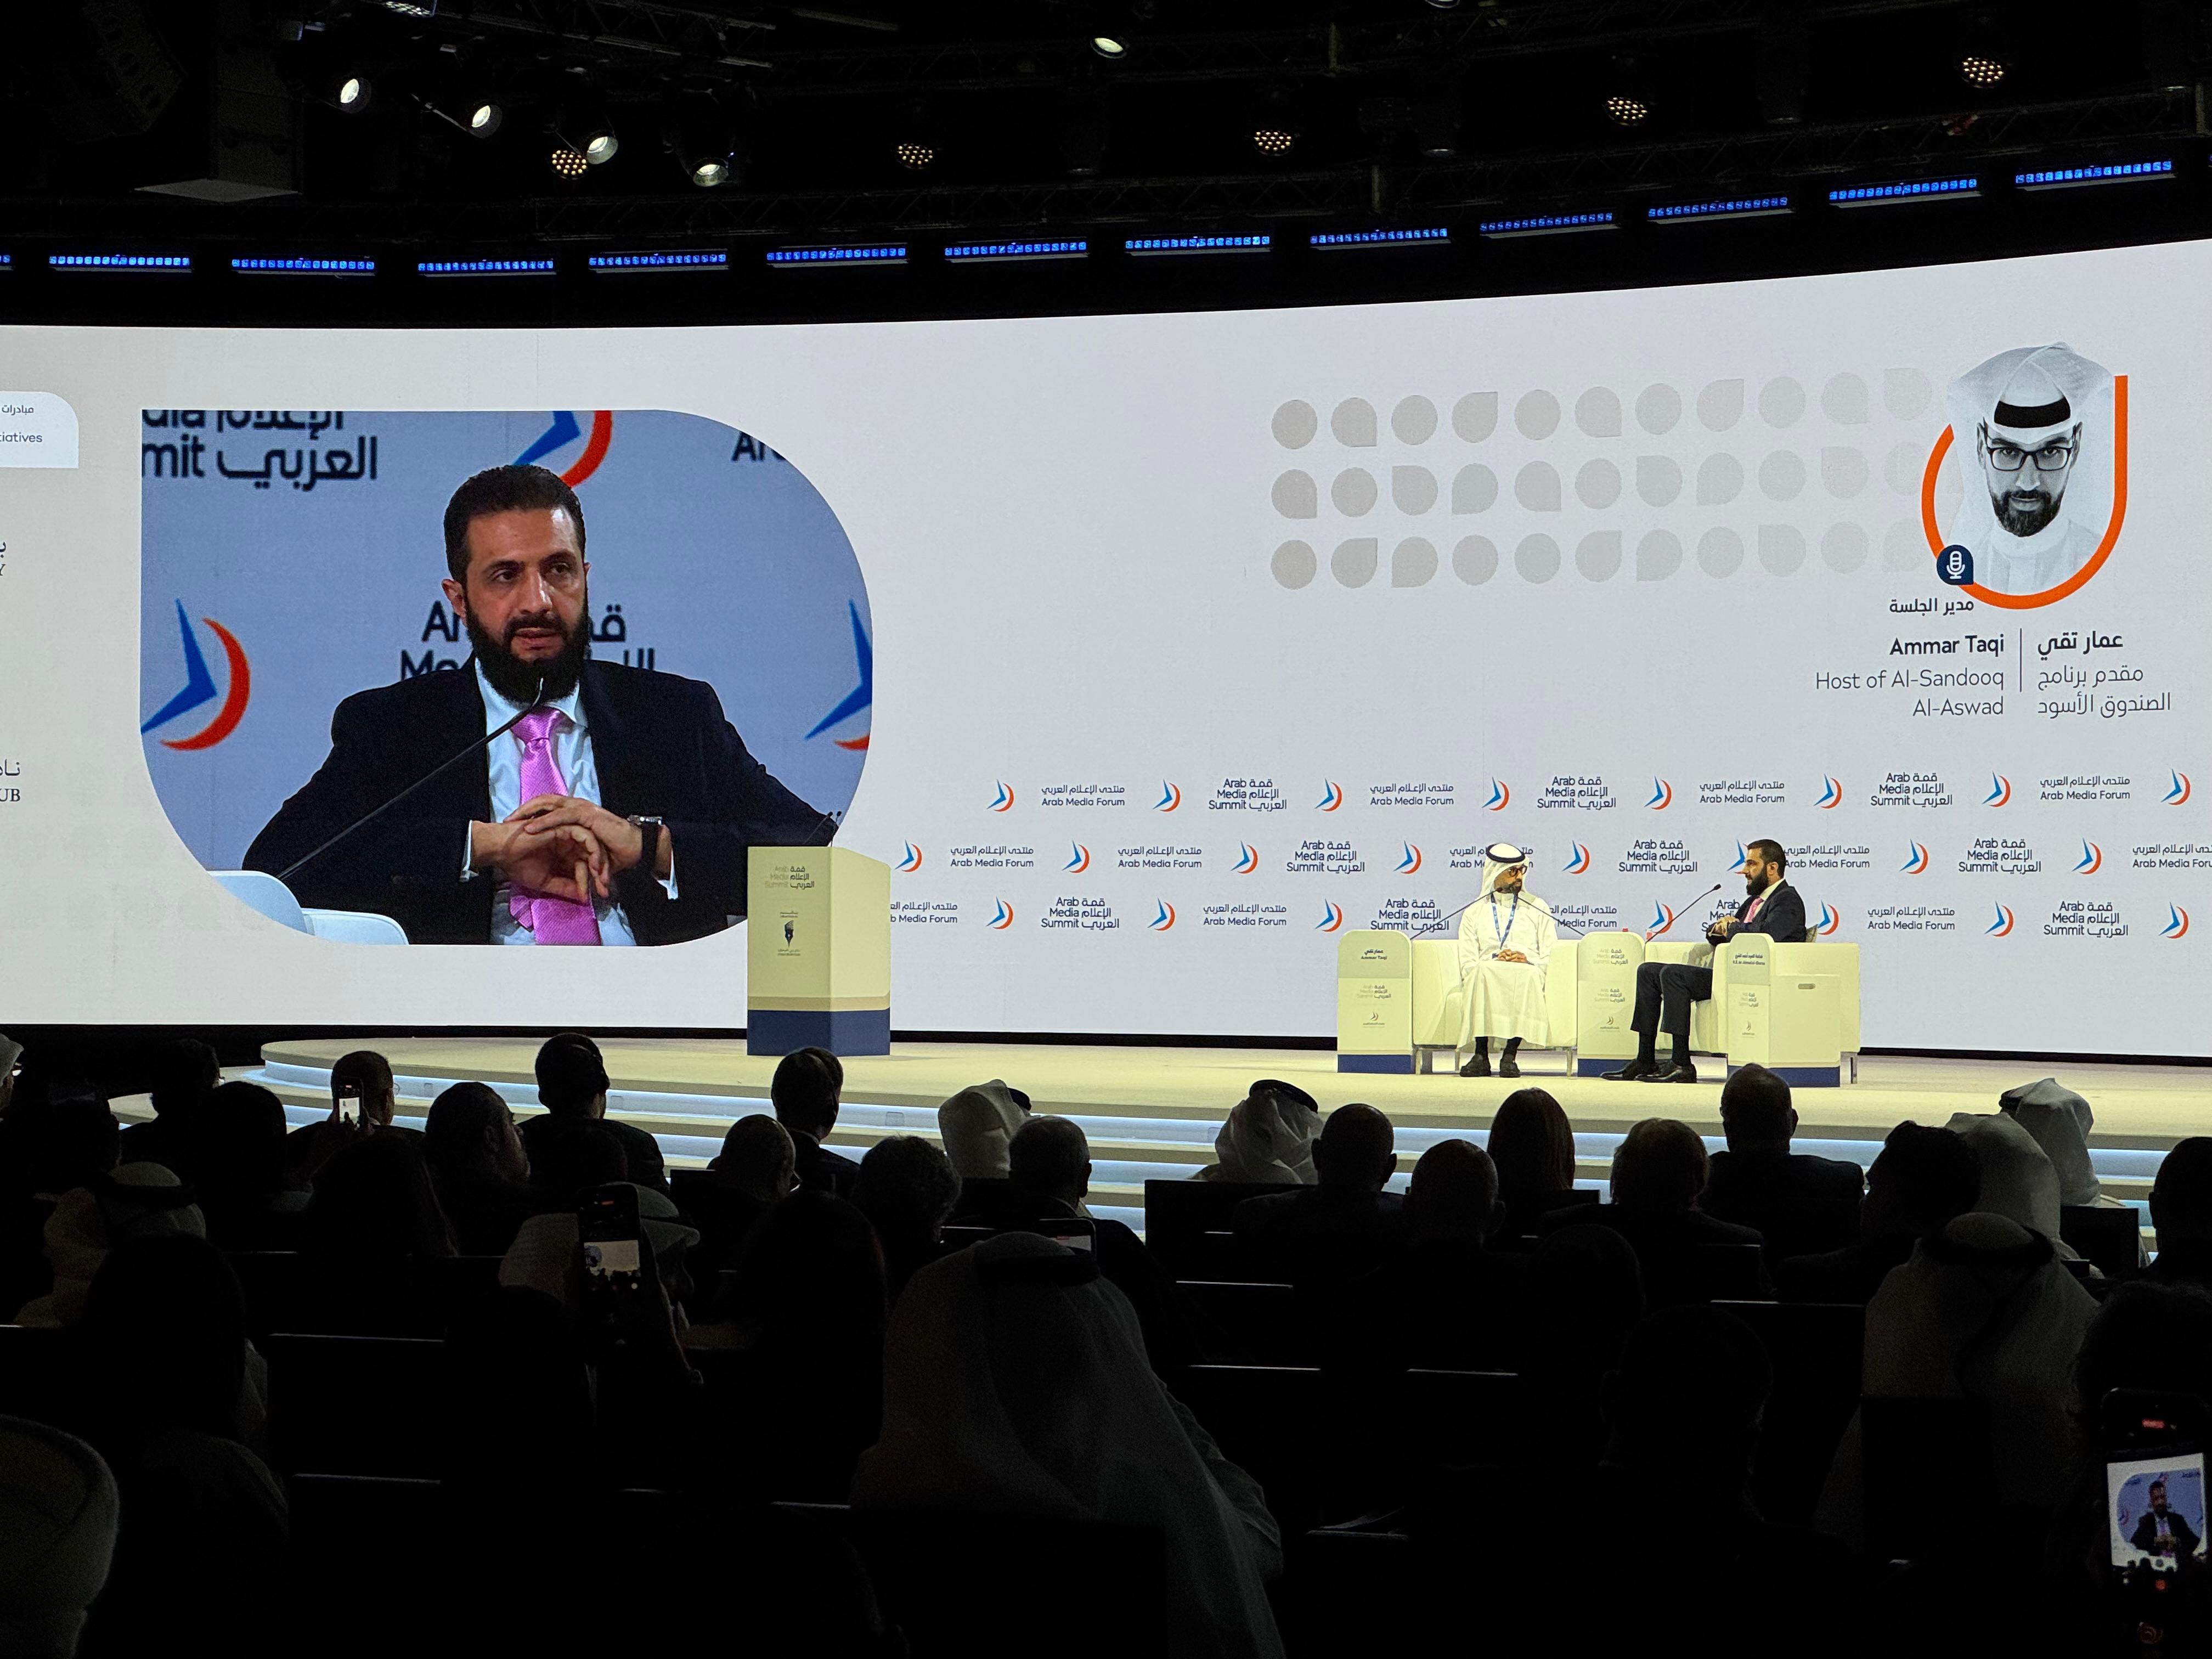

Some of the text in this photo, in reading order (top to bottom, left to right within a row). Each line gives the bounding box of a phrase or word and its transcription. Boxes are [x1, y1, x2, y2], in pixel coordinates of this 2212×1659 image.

[2, 405, 34, 416] مبادرات
[0, 432, 43, 443] iatives
[218, 436, 377, 492] العربي
[1889, 597, 1974, 616] مدير الجلسة
[1889, 634, 2004, 657] Ammar Taqi
[2038, 630, 2123, 661] عمار تقي
[1816, 669, 2004, 691] Host of Al-Sandooq
[2038, 665, 2143, 691] مقدم برنامج
[1912, 696, 2003, 716] Al-Aswad
[2038, 692, 2170, 718] الصندوق الأسود
[1552, 776, 1575, 786] Arab
[1578, 777, 1601, 785] قمة
[1886, 772, 1910, 783] Arab
[1913, 773, 1937, 782] قمة
[2040, 776, 2130, 788] منتدى الإعلام العربي
[1223, 778, 1246, 788] Arab
[1249, 779, 1273, 787] قمة
[1700, 781, 1726, 792] العربي
[1728, 780, 1756, 792] الإعلام
[1041, 785, 1068, 795] العربي
[1069, 785, 1097, 795] الإعلام
[1370, 783, 1396, 794] العربي
[1398, 783, 1426, 794] الإعلام
[1546, 787, 1575, 797] Media
[1578, 787, 1607, 799] الإعلام
[1880, 784, 1910, 794] Media
[1912, 783, 1944, 796] الإعلام
[1217, 789, 1246, 799] Media
[1249, 789, 1279, 801] الإعلام
[1700, 794, 1785, 803] Arab Media Forum
[2040, 791, 2130, 800] Arab Media Forum
[1042, 798, 1125, 806] Arab Media Forum
[1209, 800, 1246, 809] Summit
[1249, 799, 1286, 812] العربي
[1370, 797, 1454, 805] Arab Media Forum
[1537, 798, 1576, 808] Summit
[1578, 797, 1616, 810] العربي
[1871, 795, 1910, 806] Summit
[1912, 794, 1953, 808] العربي
[1301, 840, 1324, 850] Arab
[1327, 841, 1350, 850] قمة
[1634, 839, 1657, 849] Arab
[1660, 840, 1683, 849] قمة
[1974, 838, 1998, 848] Arab
[2001, 839, 2025, 848] قمة
[951, 846, 977, 856] العربي
[978, 846, 1006, 856] الإعلام
[1118, 847, 1144, 856] العربي
[1146, 846, 1174, 856] الإعلام
[1450, 847, 1476, 856] العربي
[1813, 845, 1841, 856] الإعلام
[2133, 844, 2160, 855] العربي
[2163, 844, 2193, 856] الإعلام
[1295, 851, 1324, 861] Media
[1327, 851, 1356, 863] الإعلام
[1627, 850, 1657, 861] Media
[1660, 850, 1689, 863] الإعلام
[1967, 850, 1998, 860] Media
[2001, 849, 2032, 862] الإعلام
[975, 859, 1003, 867] Media
[1118, 859, 1140, 867] Arab
[1143, 859, 1171, 867] Media
[1286, 862, 1324, 872] Summit
[1327, 862, 1364, 874] العربي
[1450, 860, 1471, 868] Arab
[1619, 862, 1657, 872] Summit
[1660, 861, 1697, 874] العربي
[1809, 859, 1838, 867] Media
[1841, 860, 1870, 868] Forum
[1959, 861, 1998, 872] Summit
[2001, 861, 2041, 874] العربي
[2132, 859, 2156, 868] Arab
[2159, 859, 2190, 867] Media
[1056, 896, 1079, 906] Arab
[1082, 898, 1105, 906] قمة
[1385, 898, 1409, 908] Arab
[1412, 900, 1435, 908] قمة
[1716, 899, 1740, 909] Arab
[2059, 901, 2084, 911] Arab
[902, 902, 930, 912] الإعلام
[1203, 904, 1229, 914] العربي
[1231, 904, 1259, 915] الإعلام
[1561, 905, 1589, 916] الإعلام
[1868, 906, 1895, 917] العربي
[2087, 902, 2113, 911] قمة
[1050, 907, 1079, 917] Media
[1081, 907, 1111, 919] الإعلام
[1379, 909, 1409, 919] Media
[1412, 909, 1441, 922] الإعلام
[1897, 907, 1926, 918] الإعلام
[1203, 917, 1225, 925] Arab
[2052, 912, 2084, 923] Media
[2087, 912, 2119, 926] الإعلام
[1041, 918, 1079, 928] Summit
[1081, 918, 1119, 930] العربي
[1370, 921, 1409, 930] Summit
[1588, 919, 1617, 927] Forum
[1868, 921, 1955, 930] Arab Media Forum
[2044, 924, 2084, 935] Summit
[2087, 924, 2128, 938] العربي
